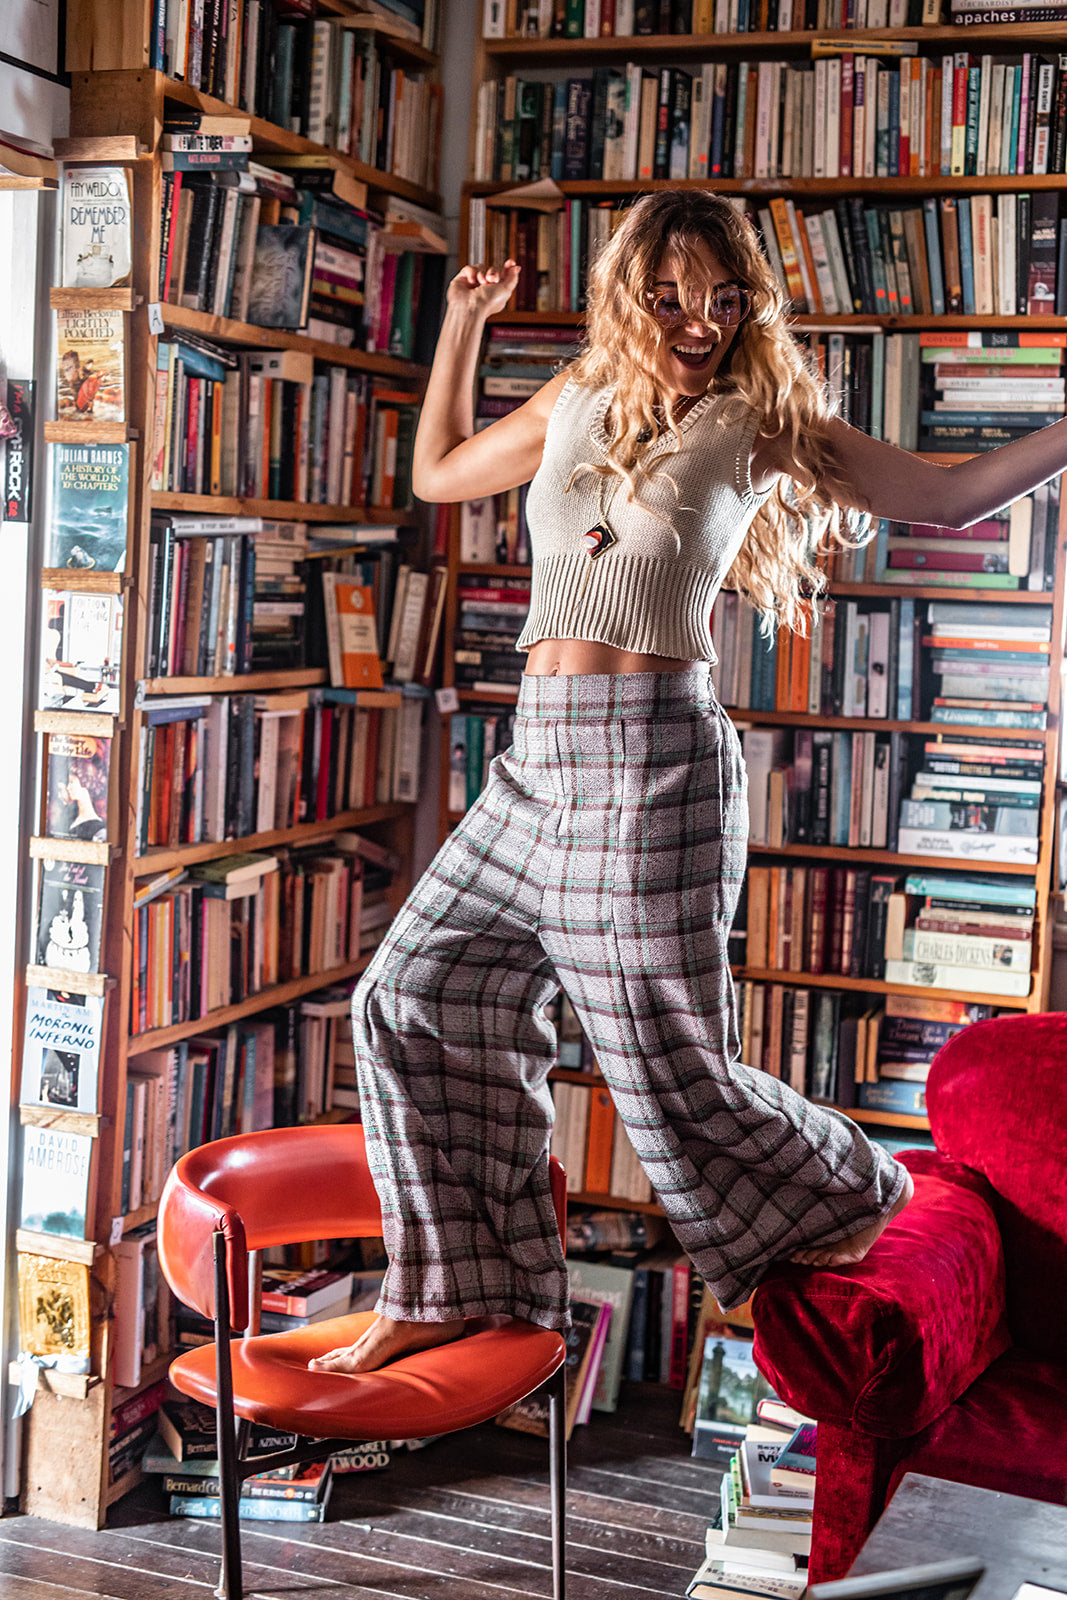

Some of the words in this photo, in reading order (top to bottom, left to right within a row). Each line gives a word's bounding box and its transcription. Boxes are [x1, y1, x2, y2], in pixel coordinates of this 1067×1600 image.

[955, 10, 1016, 26] apaches
[1042, 68, 1050, 89] Judith
[1041, 91, 1050, 112] Cutler
[71, 182, 84, 197] FAY
[85, 182, 122, 197] WELDO
[71, 206, 126, 225] REMEMBER
[91, 225, 105, 243] ME
[66, 319, 109, 329] LIGHTLY
[64, 328, 114, 338] POACHED
[60, 449, 88, 463] JULIAN
[91, 450, 123, 465] BARNES
[60, 472, 77, 481] THE
[78, 474, 110, 482] WORLD
[110, 475, 121, 483] IN
[64, 465, 71, 473] A
[72, 465, 106, 474] HISTORY
[106, 466, 119, 474] OF
[73, 481, 118, 491] CHAPTERS
[75, 746, 93, 755] Life
[916, 941, 954, 962] CHARLES
[956, 945, 991, 967] DICKENS
[30, 1013, 94, 1035] MORONIC
[29, 1028, 95, 1049] INFERNO
[40, 1133, 77, 1152] DAVID
[28, 1146, 86, 1176] AMBROSE
[187, 1443, 217, 1455] Bernar
[331, 1453, 390, 1470] TWOOD
[166, 1479, 206, 1493] Bernard
